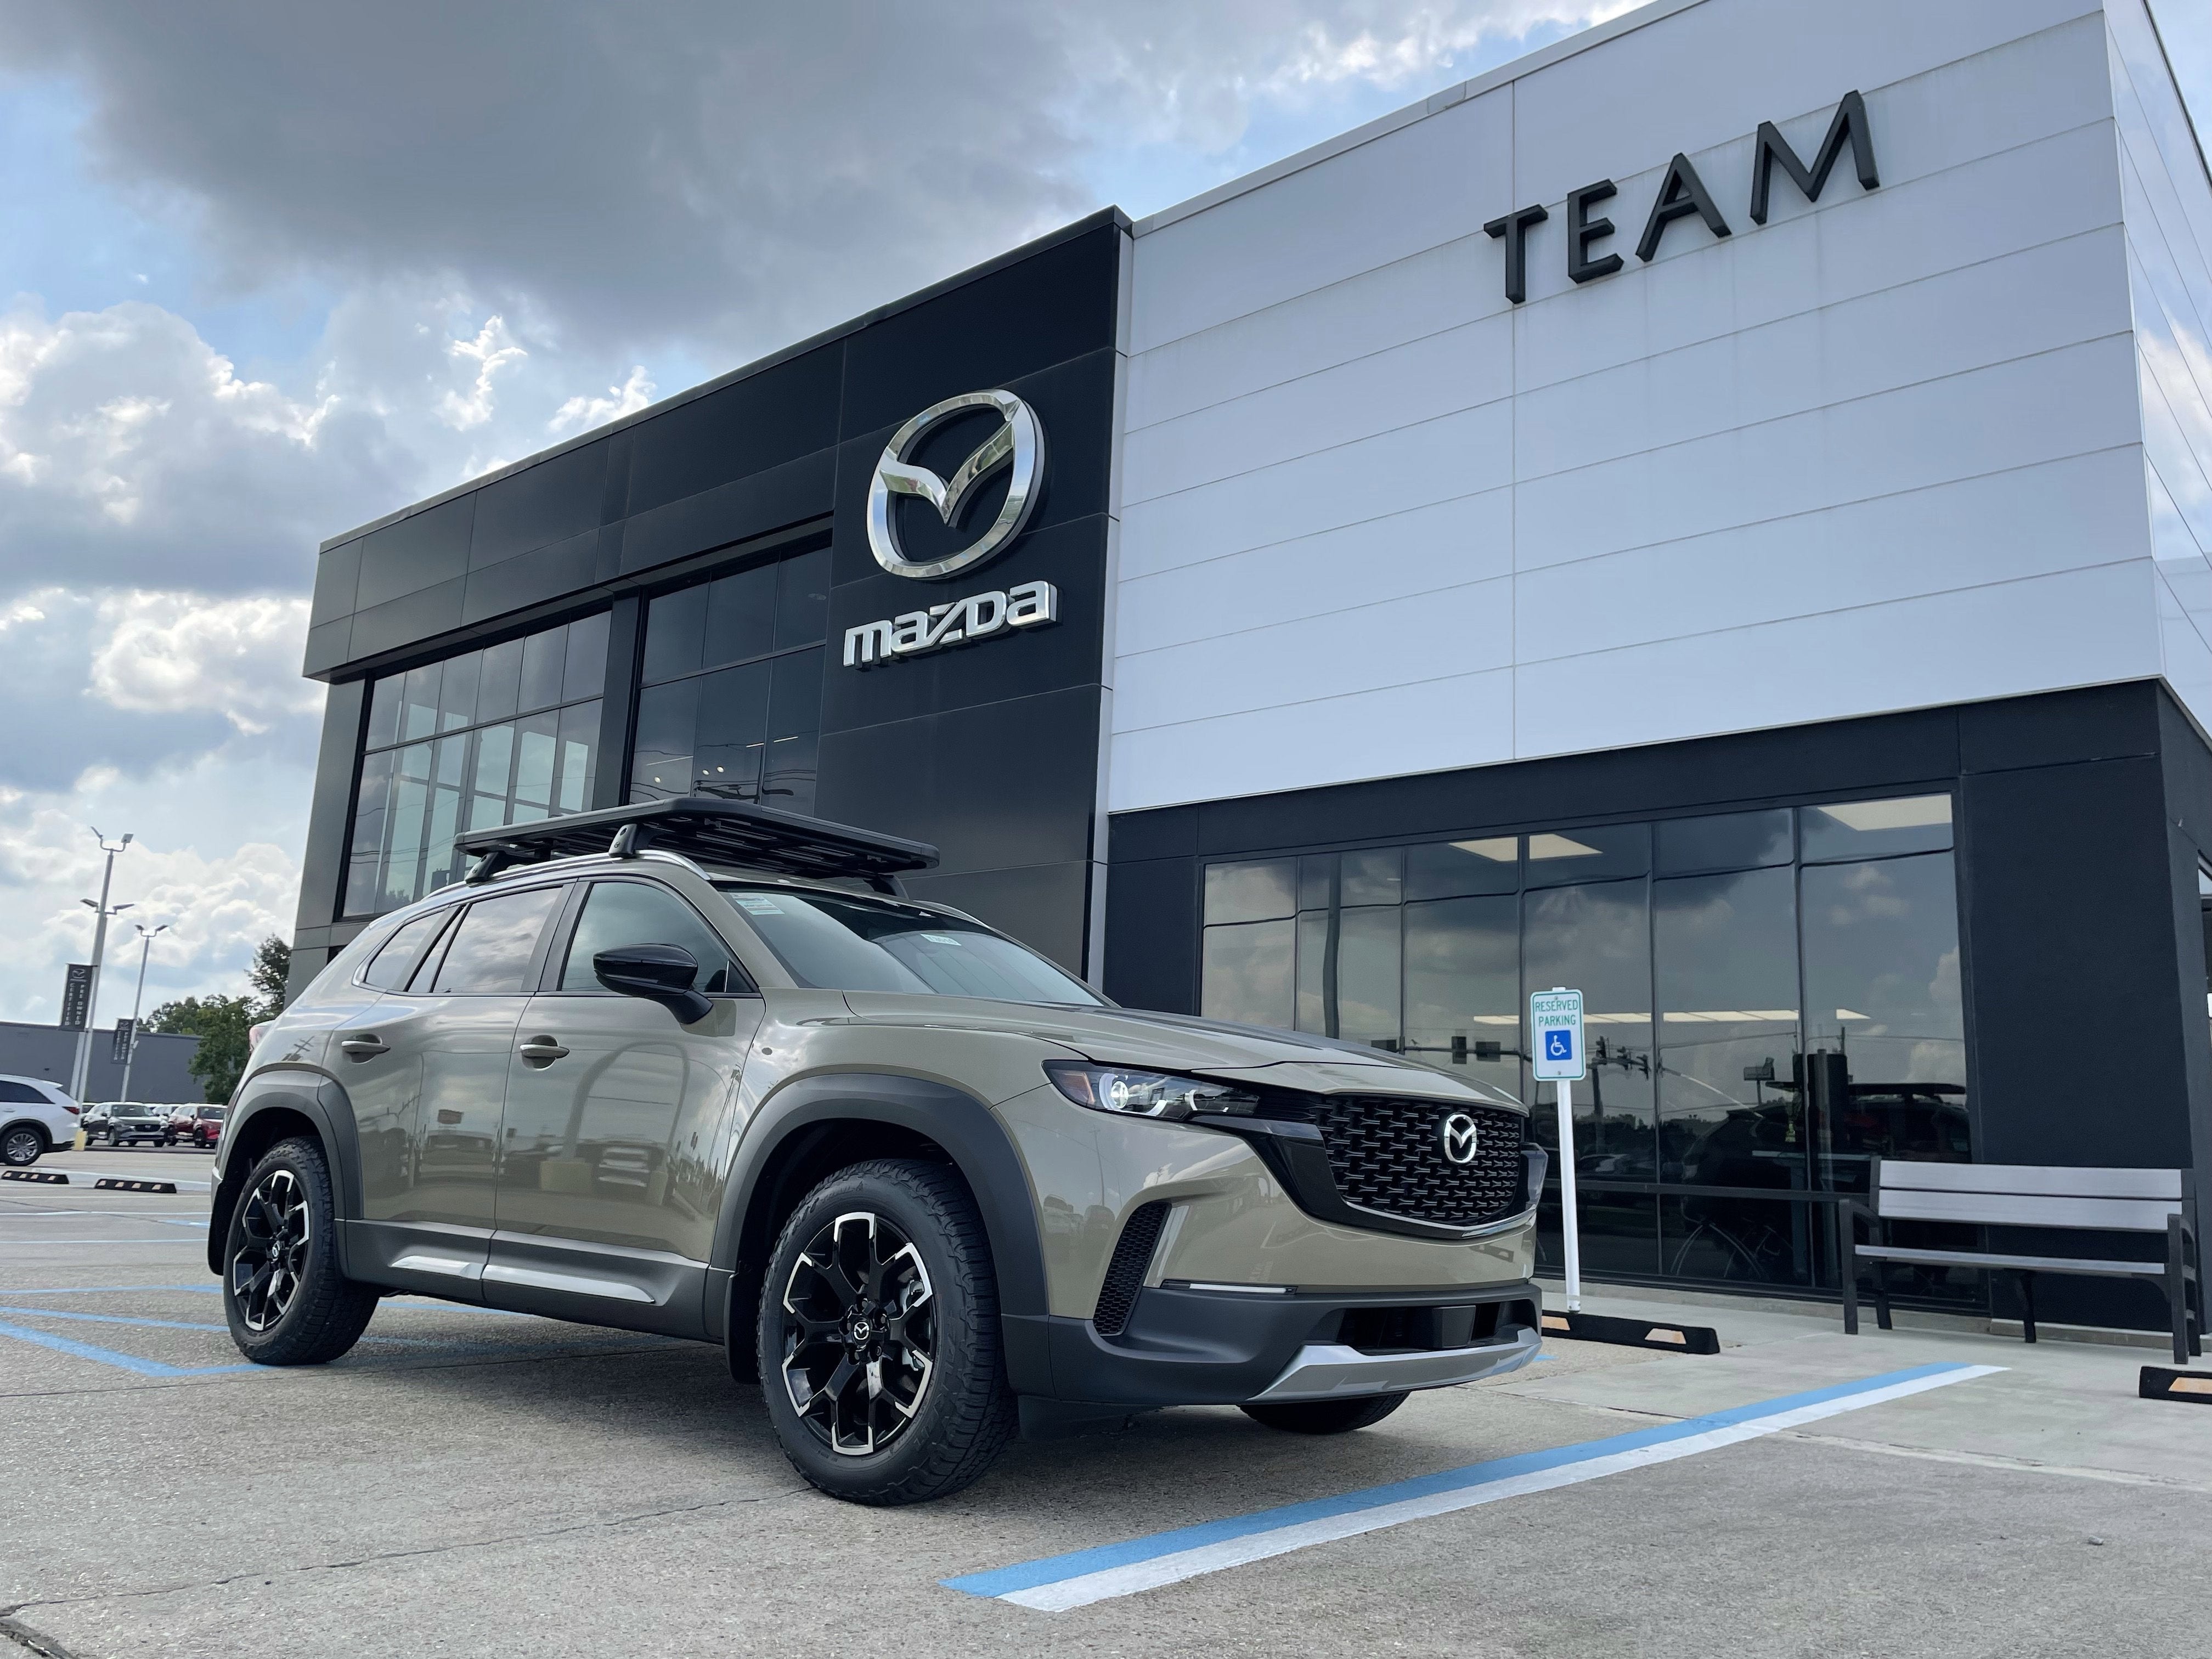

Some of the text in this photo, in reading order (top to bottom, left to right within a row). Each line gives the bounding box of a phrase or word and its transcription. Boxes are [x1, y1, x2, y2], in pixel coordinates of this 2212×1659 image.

[1483, 89, 1880, 304] TEAM
[1535, 1000, 1578, 1012] RESERVED
[1538, 1014, 1576, 1027] PARKING
